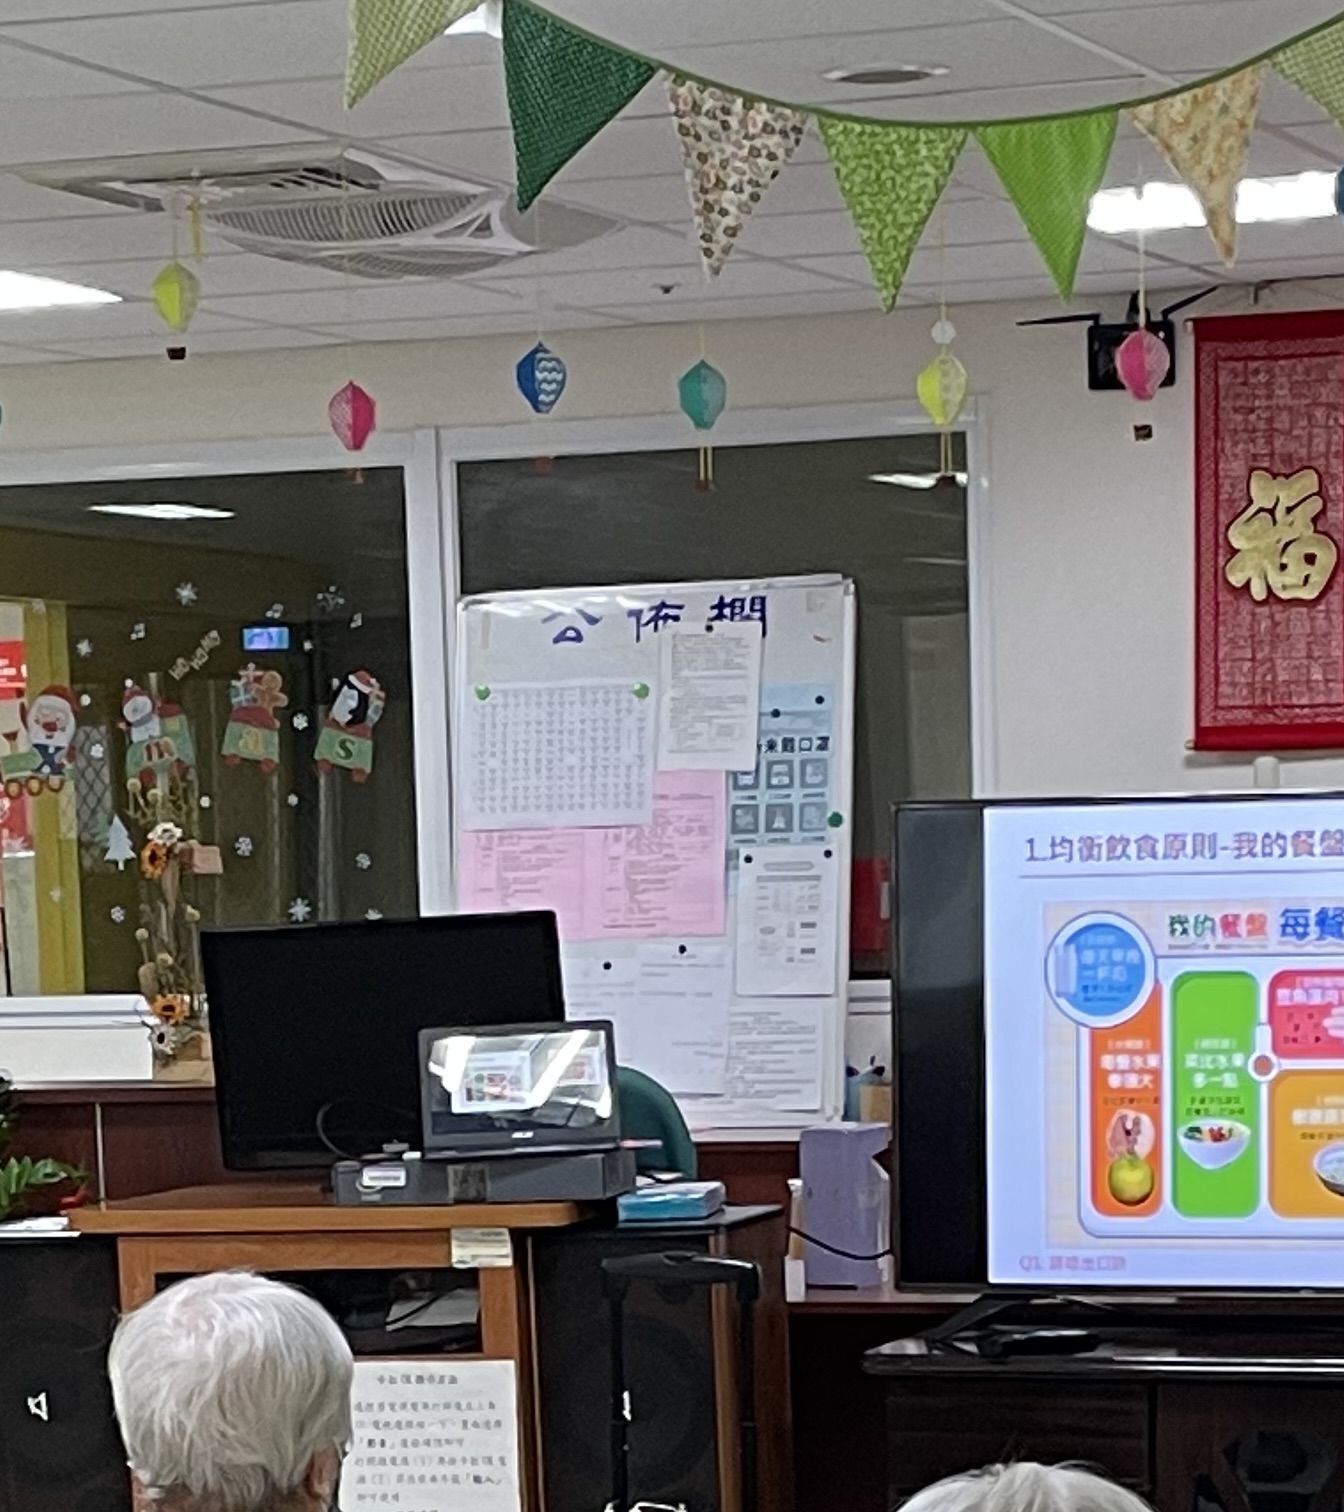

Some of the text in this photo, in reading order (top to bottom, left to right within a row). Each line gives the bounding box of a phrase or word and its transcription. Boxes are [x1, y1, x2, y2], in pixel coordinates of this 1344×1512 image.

[1224, 467, 1338, 601] 福
[758, 736, 830, 754] 來戴口罩
[1168, 913, 1268, 939] 我的餐盤
